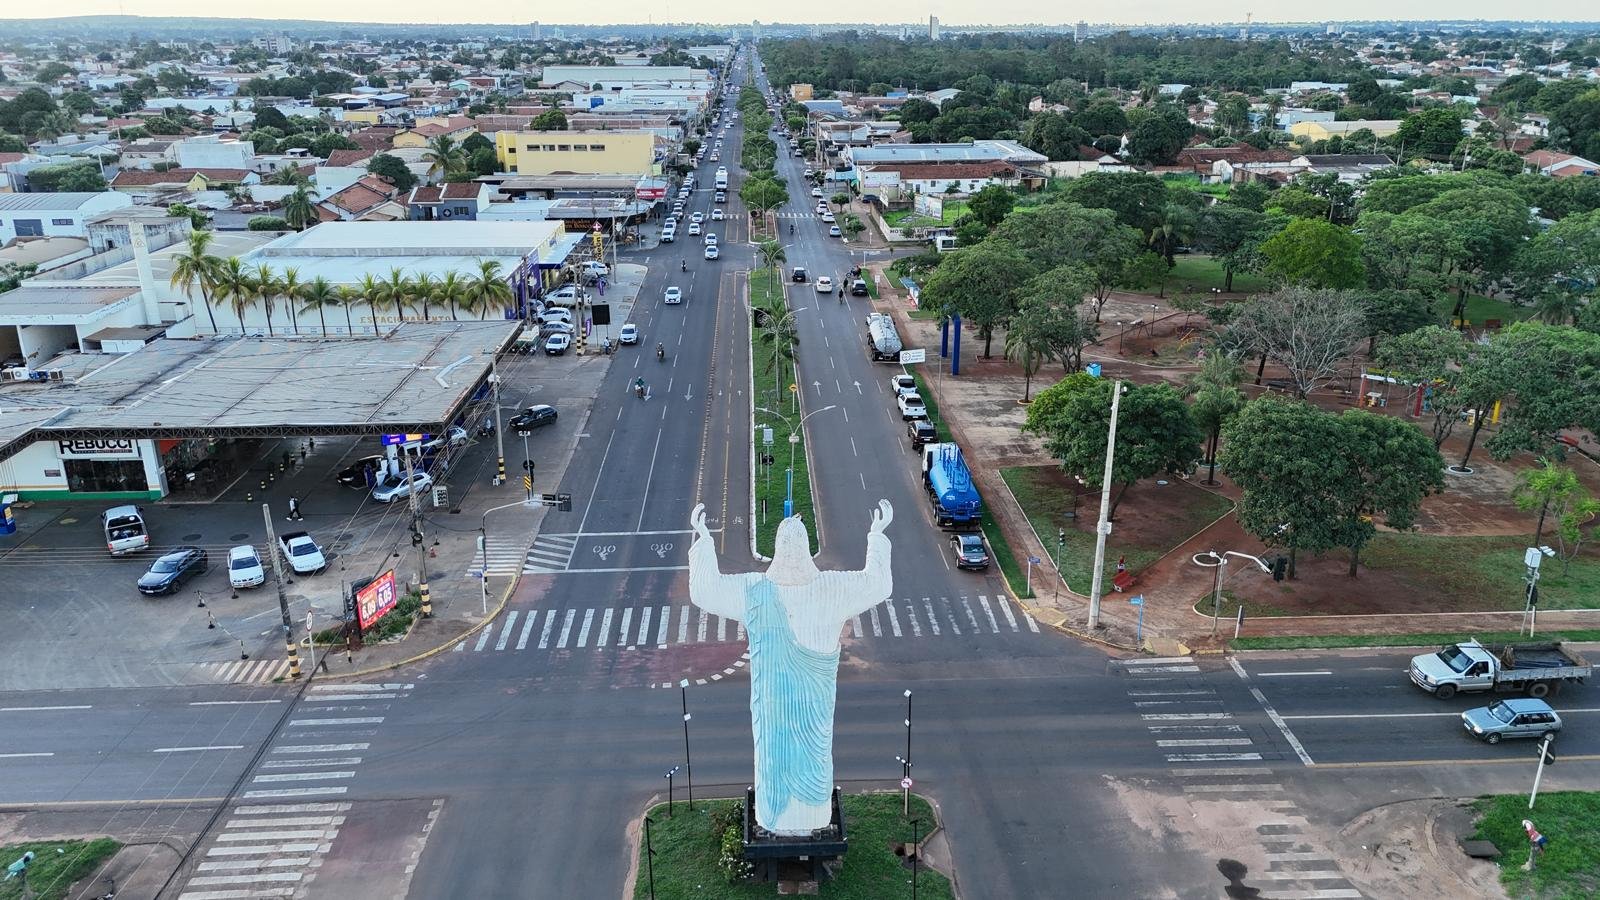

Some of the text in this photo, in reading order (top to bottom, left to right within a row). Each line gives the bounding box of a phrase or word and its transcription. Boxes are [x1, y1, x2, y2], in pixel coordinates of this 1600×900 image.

[59, 440, 133, 454] REBUCCI
[378, 586, 392, 608] 6,05
[362, 599, 376, 620] 6,09
